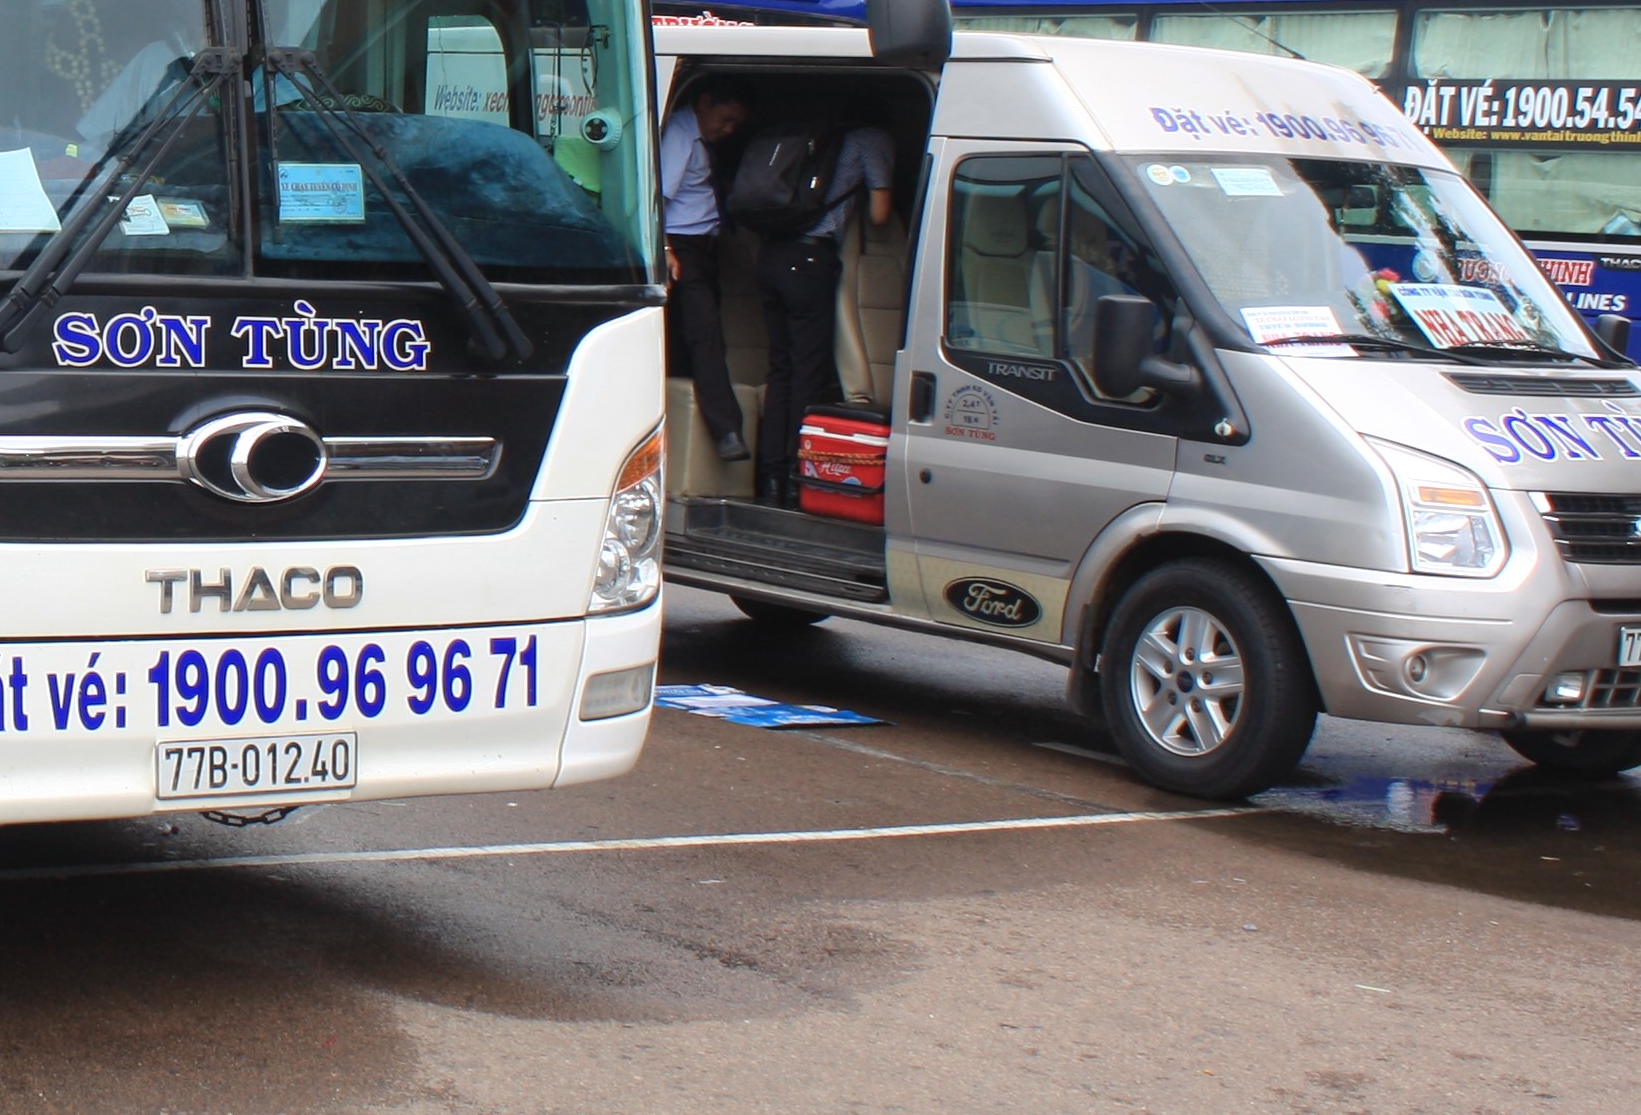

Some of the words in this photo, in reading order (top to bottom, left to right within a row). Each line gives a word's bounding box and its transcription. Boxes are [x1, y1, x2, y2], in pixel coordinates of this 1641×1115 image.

[434, 85, 481, 113] Website:
[1404, 78, 1456, 135] ĐẶT
[1460, 78, 1499, 127] VÉ:
[1150, 107, 1210, 140] Đặt
[1208, 110, 1257, 136] vé:
[1433, 127, 1487, 140] Website:
[52, 306, 209, 370] SƠN
[231, 300, 431, 372] TÙNG
[1413, 309, 1472, 346] NHA
[1454, 310, 1532, 342] TRANG
[988, 363, 1056, 381] TRANSIT
[1461, 406, 1604, 466] SƠN
[144, 564, 364, 614] THACO
[963, 582, 1022, 621] Ford
[46, 652, 127, 731] vé:
[148, 642, 385, 729] 1900.96
[406, 638, 472, 714] 96
[488, 634, 539, 711] 71
[165, 740, 350, 792] 77B-012.40
